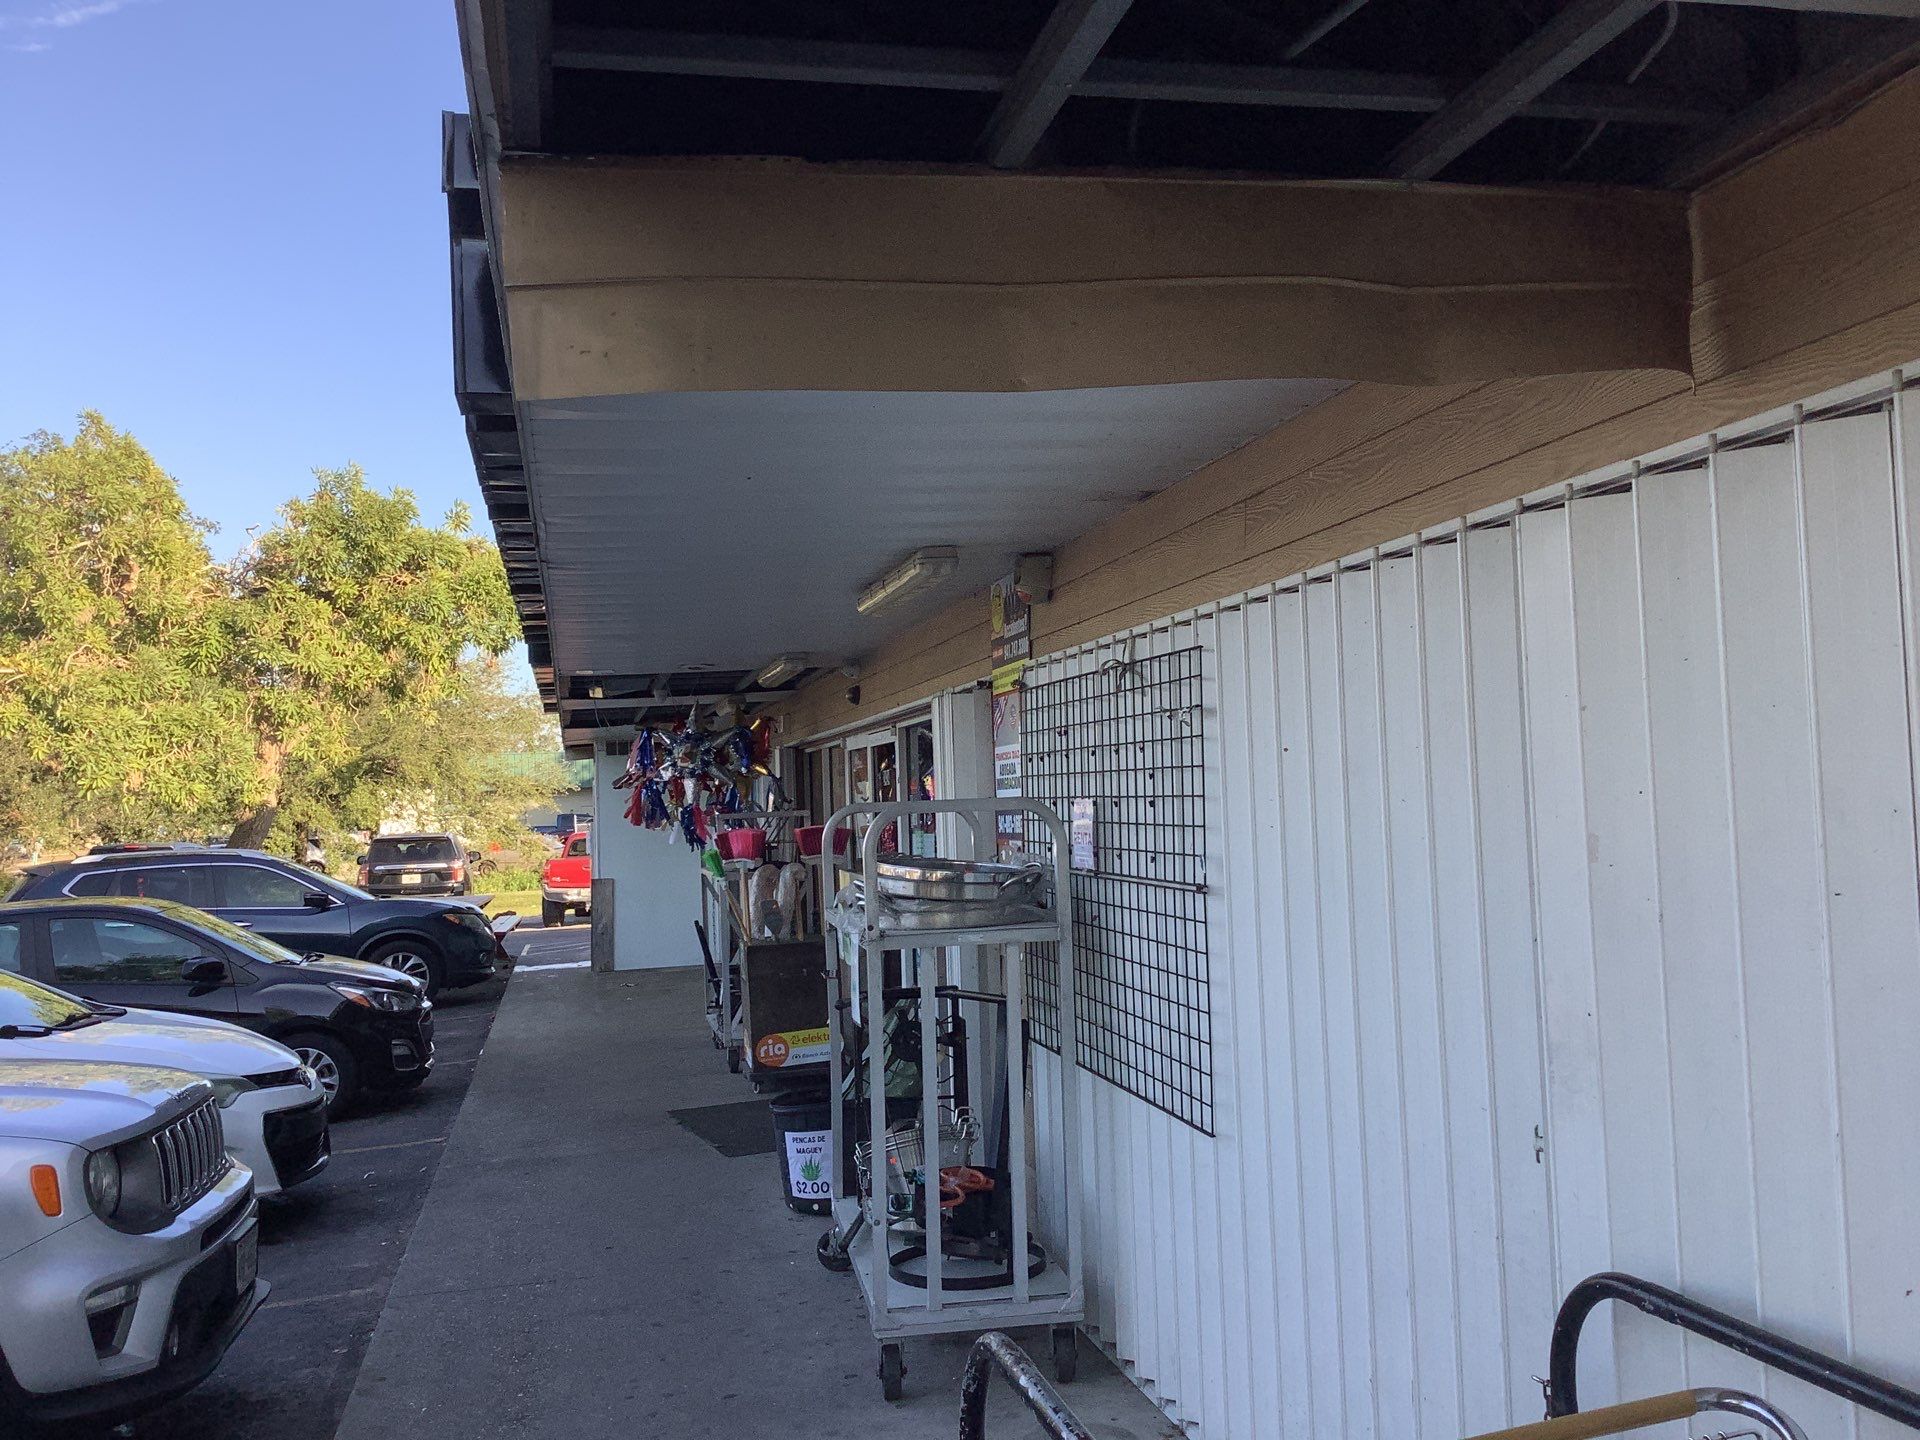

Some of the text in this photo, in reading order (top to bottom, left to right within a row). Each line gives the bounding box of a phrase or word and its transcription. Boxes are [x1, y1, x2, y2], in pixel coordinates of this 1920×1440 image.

[999, 762, 1017, 776] ABOGADA
[760, 1039, 786, 1058] ria
[791, 1135, 826, 1144] PENCAS DE
[796, 1180, 830, 1195] $2.00
